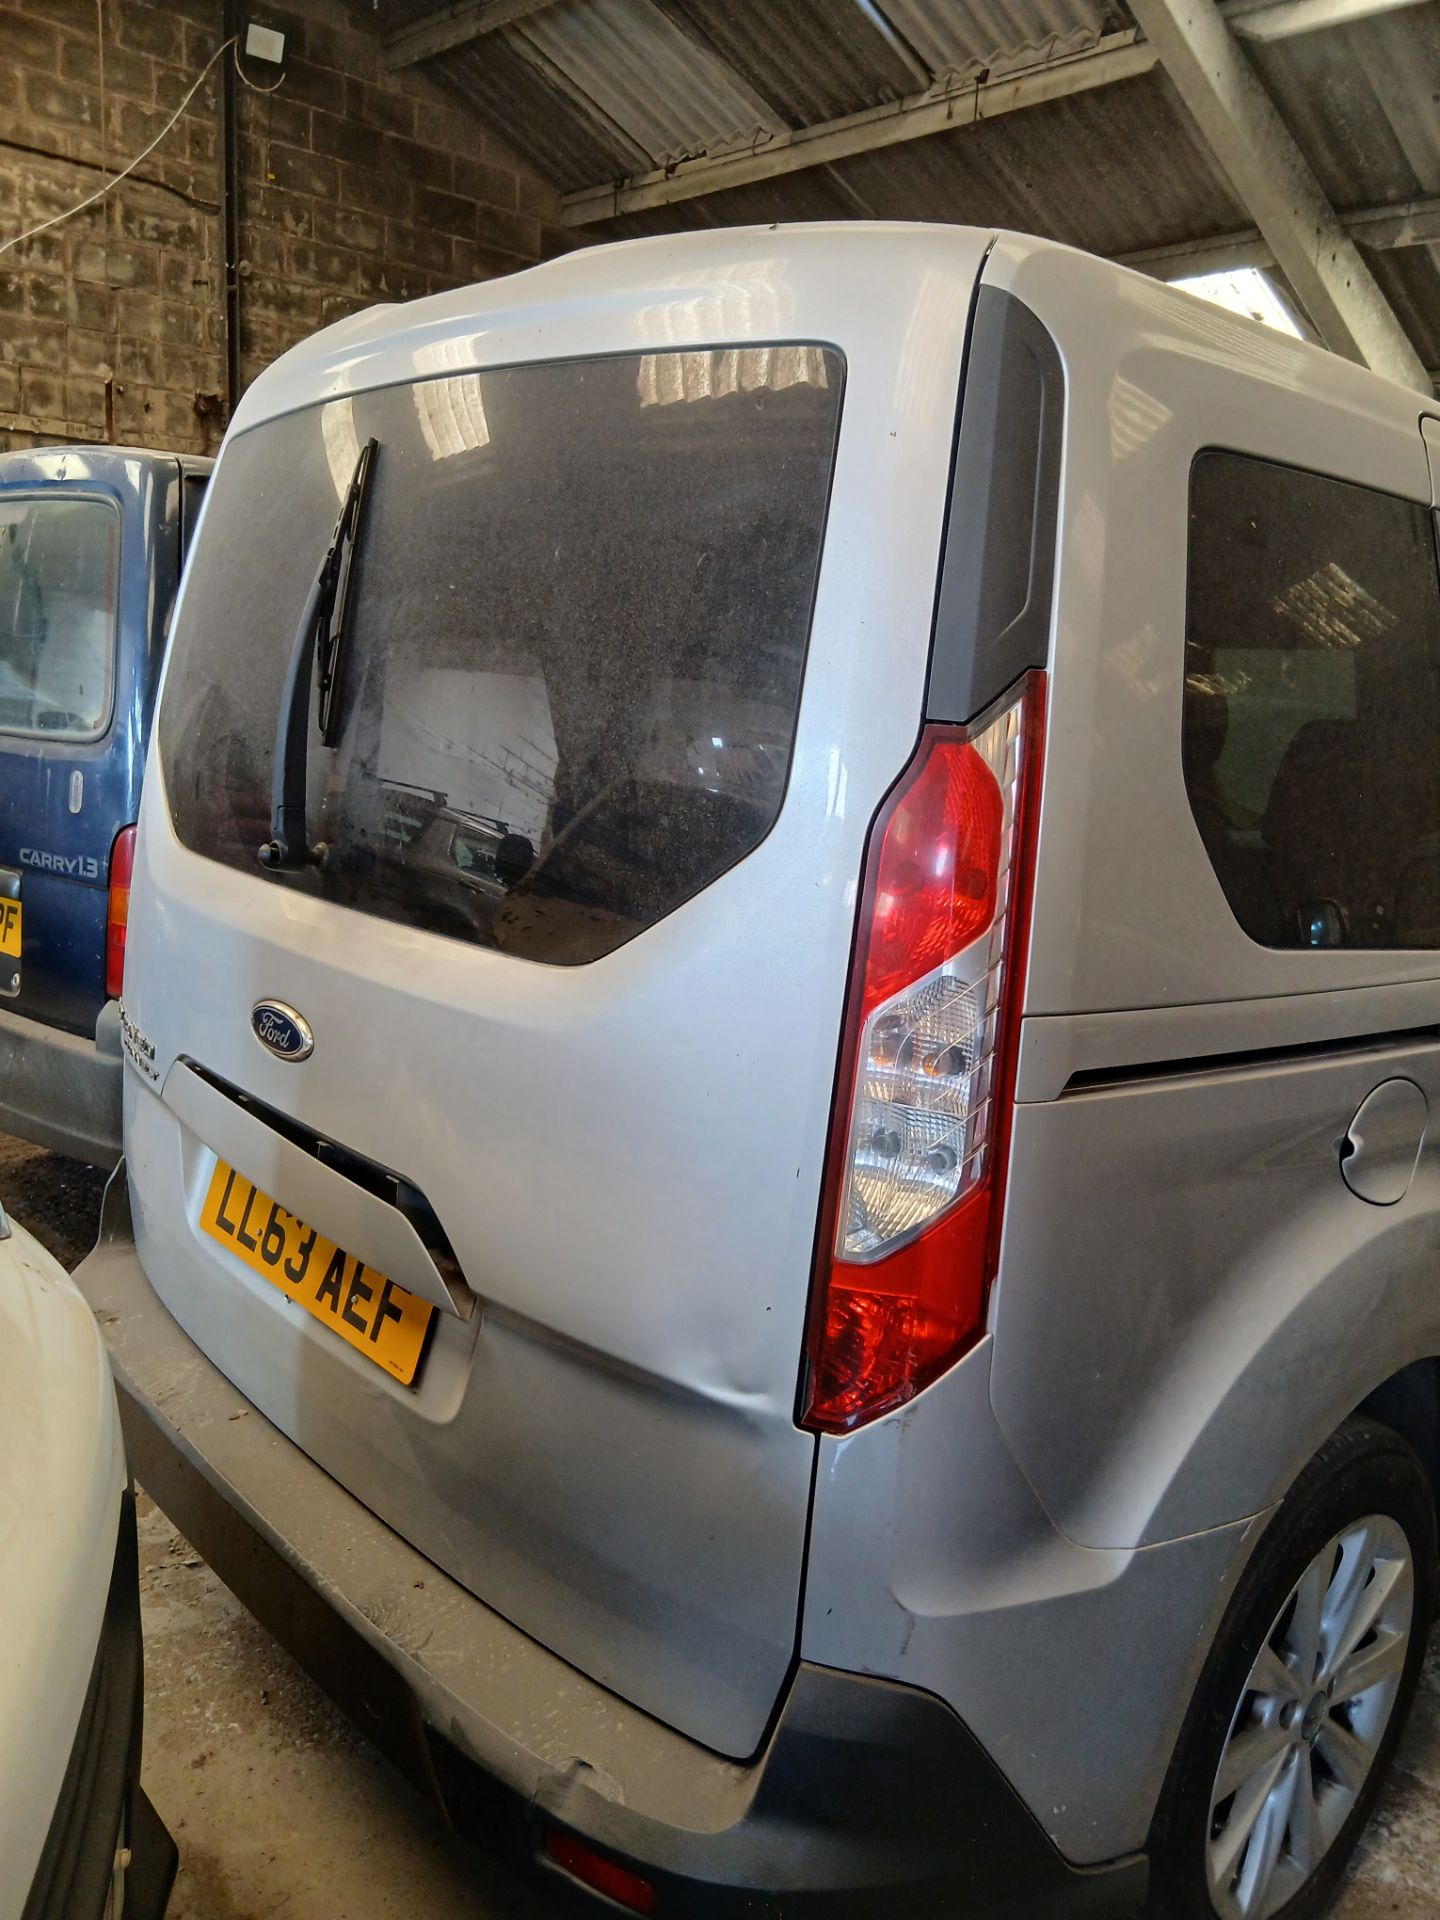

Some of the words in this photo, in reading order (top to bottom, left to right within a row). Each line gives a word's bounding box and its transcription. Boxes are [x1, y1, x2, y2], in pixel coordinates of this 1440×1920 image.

[259, 1012, 291, 1048] Ford
[216, 1168, 318, 1284] LL63
[314, 1246, 413, 1343] AEF
